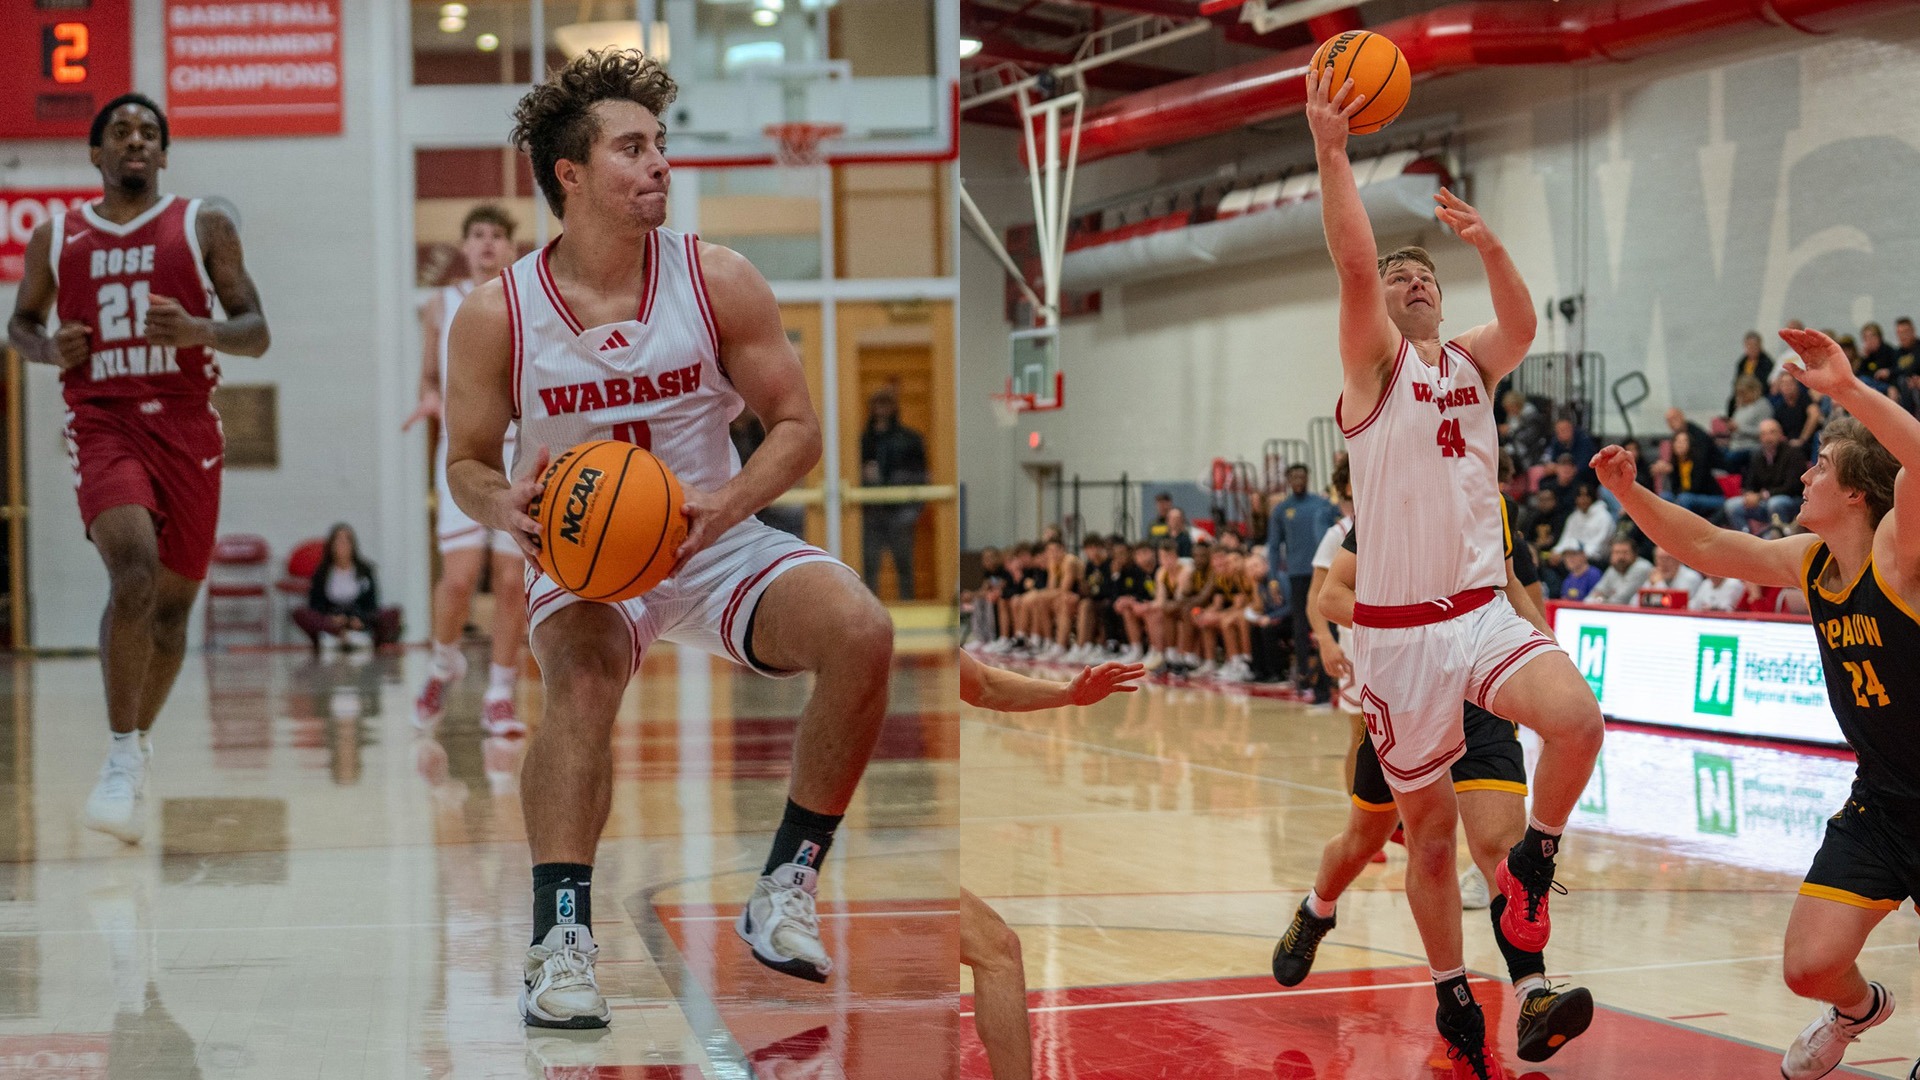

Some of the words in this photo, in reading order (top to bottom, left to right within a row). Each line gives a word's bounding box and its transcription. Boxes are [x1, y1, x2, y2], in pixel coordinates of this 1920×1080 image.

[170, 2, 334, 28] BASKETBALL
[53, 22, 89, 83] 2
[172, 33, 335, 58] TOURNAMENT
[1324, 31, 1362, 69] Wilso
[170, 63, 337, 92] CHAMPIONS
[90, 244, 156, 278] ROSE
[97, 280, 151, 342] 21
[539, 362, 702, 416] WABASH
[1436, 417, 1467, 458] 44
[560, 467, 604, 545] NCAA
[1842, 660, 1891, 708] 24
